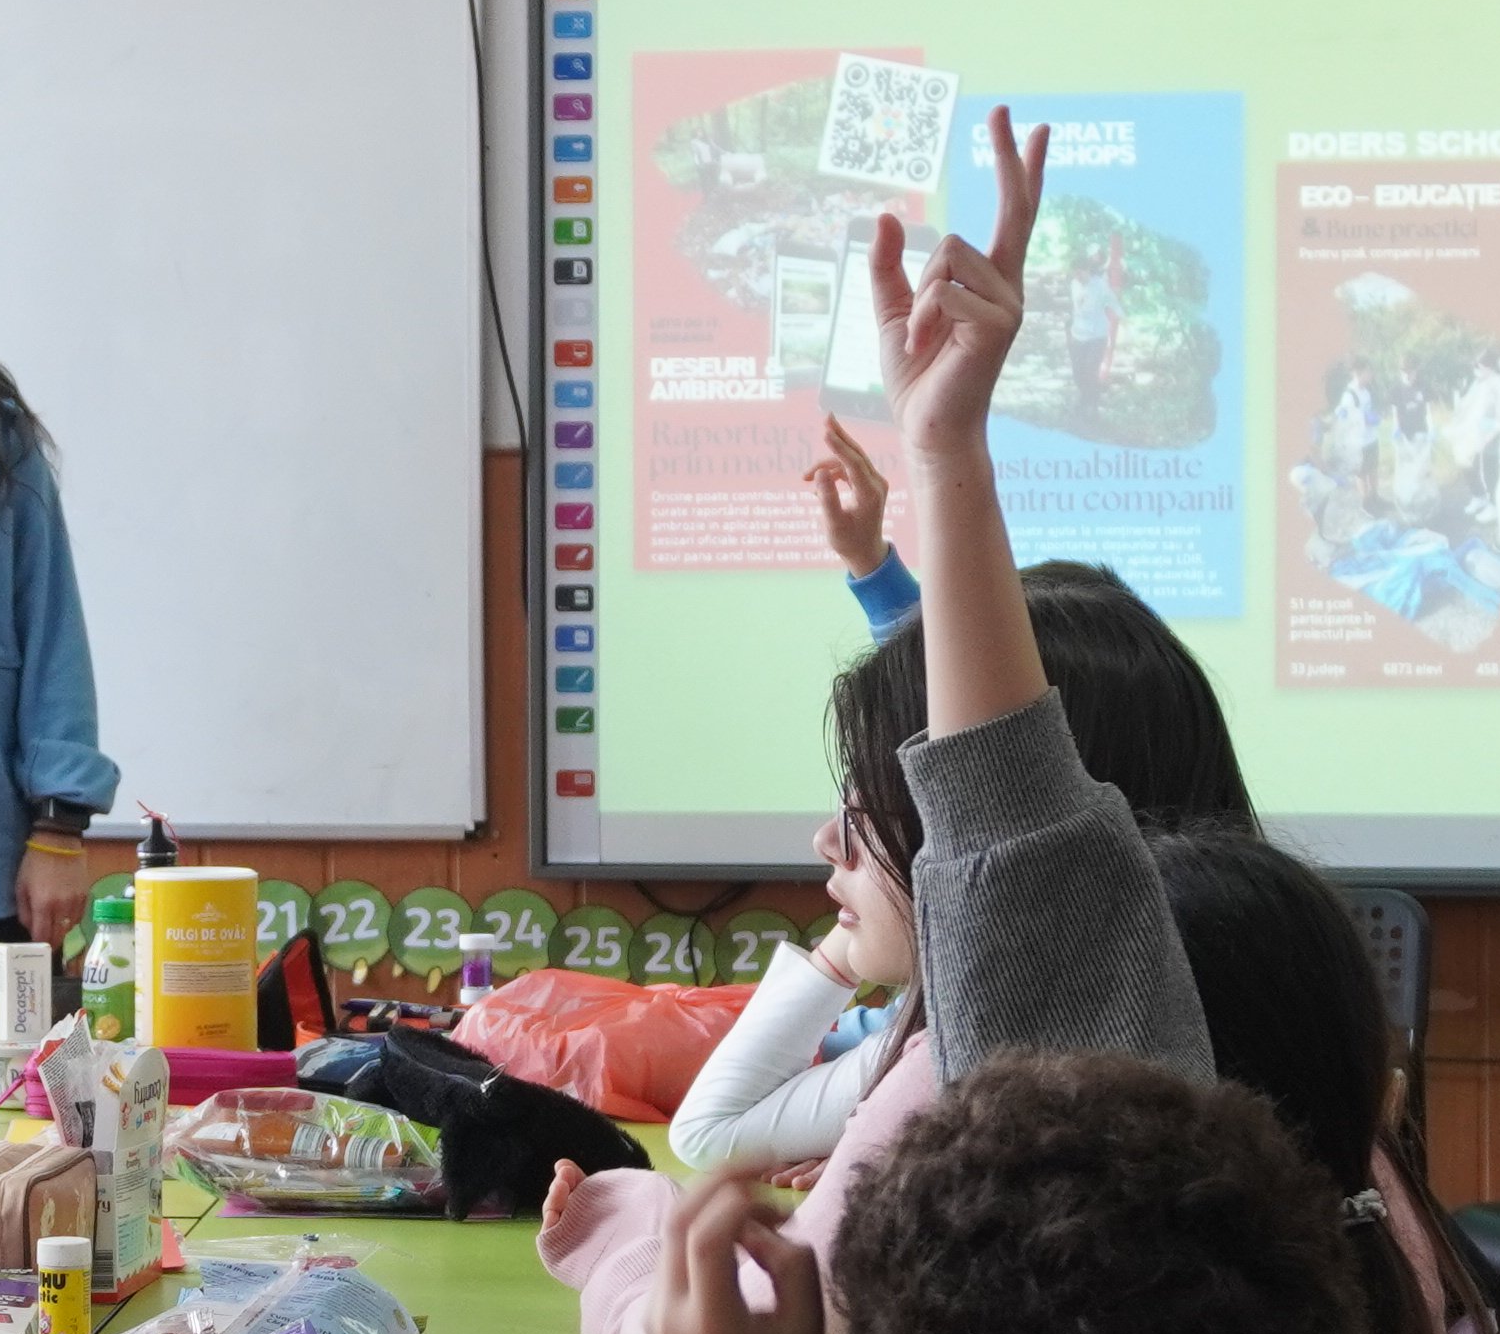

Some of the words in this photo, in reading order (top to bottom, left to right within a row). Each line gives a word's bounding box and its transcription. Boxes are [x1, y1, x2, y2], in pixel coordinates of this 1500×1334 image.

[1289, 131, 1406, 157] DOERS
[650, 379, 785, 400] AMBROZIE
[995, 450, 1203, 480] ustenabilitate
[1083, 484, 1233, 517] companii
[166, 927, 198, 941] FULGI
[201, 927, 216, 941] DE
[257, 901, 299, 941] 21
[320, 898, 382, 944] 22
[404, 906, 462, 948] 23
[485, 908, 547, 949] 24
[565, 925, 622, 967] 25
[644, 930, 702, 973] 26
[733, 931, 790, 971] 27
[14, 969, 31, 1033] Decasept
